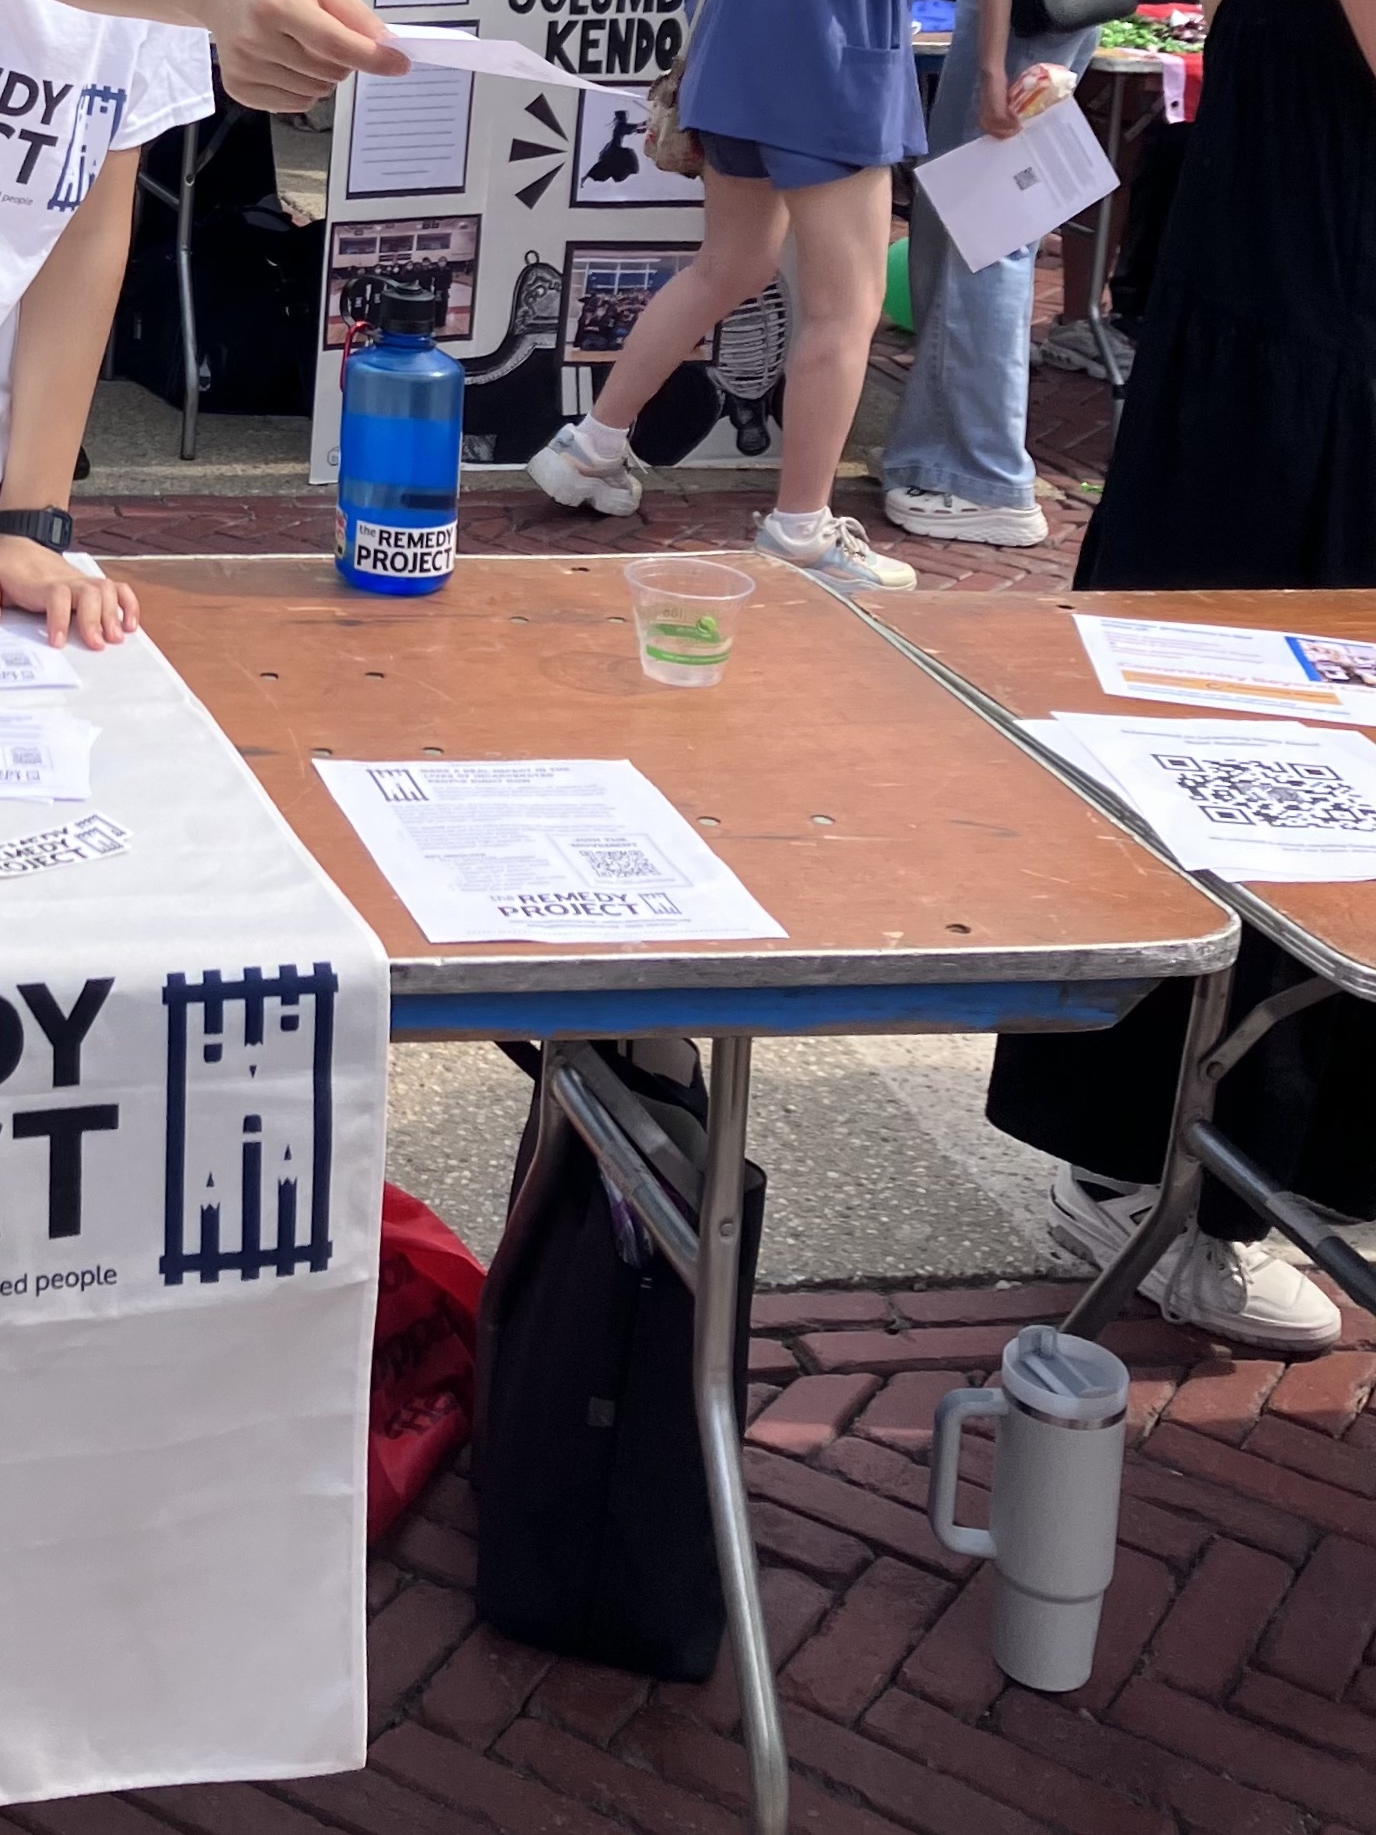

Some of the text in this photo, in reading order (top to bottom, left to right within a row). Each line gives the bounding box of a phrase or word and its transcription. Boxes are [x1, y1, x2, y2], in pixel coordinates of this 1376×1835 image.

[545, 18, 683, 74] KENDO
[359, 524, 454, 549] the REMEDY
[356, 544, 453, 574] PROJECT
[490, 892, 629, 904] the REMEDY
[497, 902, 640, 917] PROJECT
[35, 1264, 119, 1298] people
